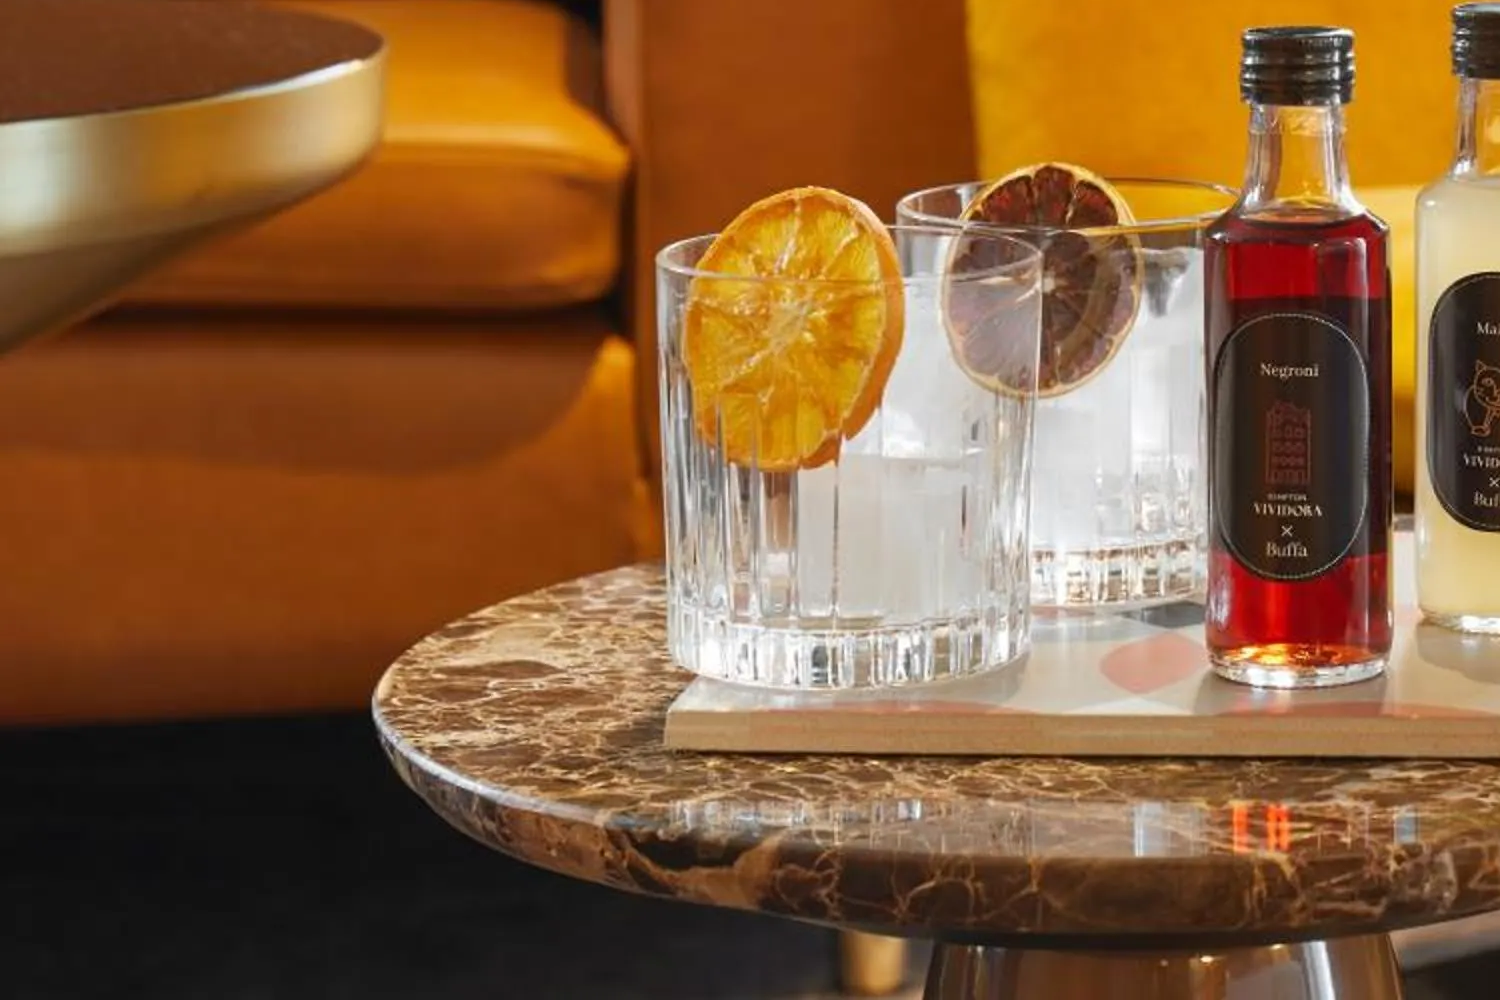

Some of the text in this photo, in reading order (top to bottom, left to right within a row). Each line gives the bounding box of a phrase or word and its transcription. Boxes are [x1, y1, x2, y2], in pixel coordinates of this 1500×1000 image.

[1260, 363, 1319, 380] Negroni
[1253, 501, 1323, 517] VIVIDORA
[1266, 541, 1308, 557] Buffa
